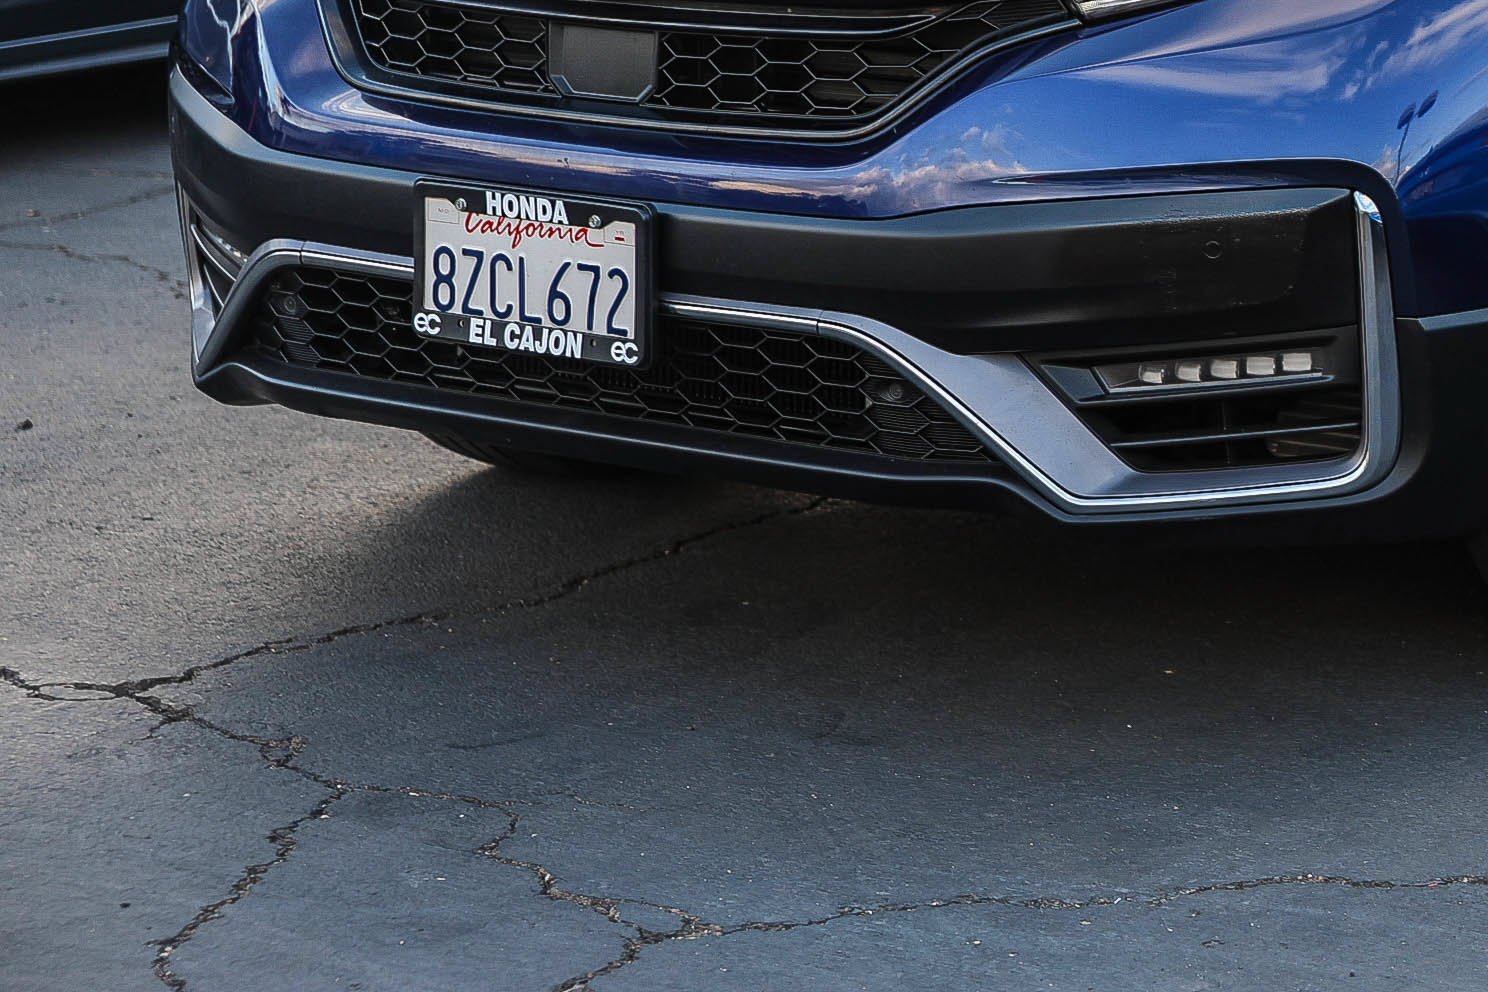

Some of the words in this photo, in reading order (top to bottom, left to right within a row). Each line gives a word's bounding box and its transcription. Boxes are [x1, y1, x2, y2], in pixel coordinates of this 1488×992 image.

[485, 191, 569, 225] HONDA
[465, 211, 605, 248] California
[431, 245, 629, 338] 8ZCL672
[468, 317, 497, 346] EL
[504, 322, 583, 358] CAJON
